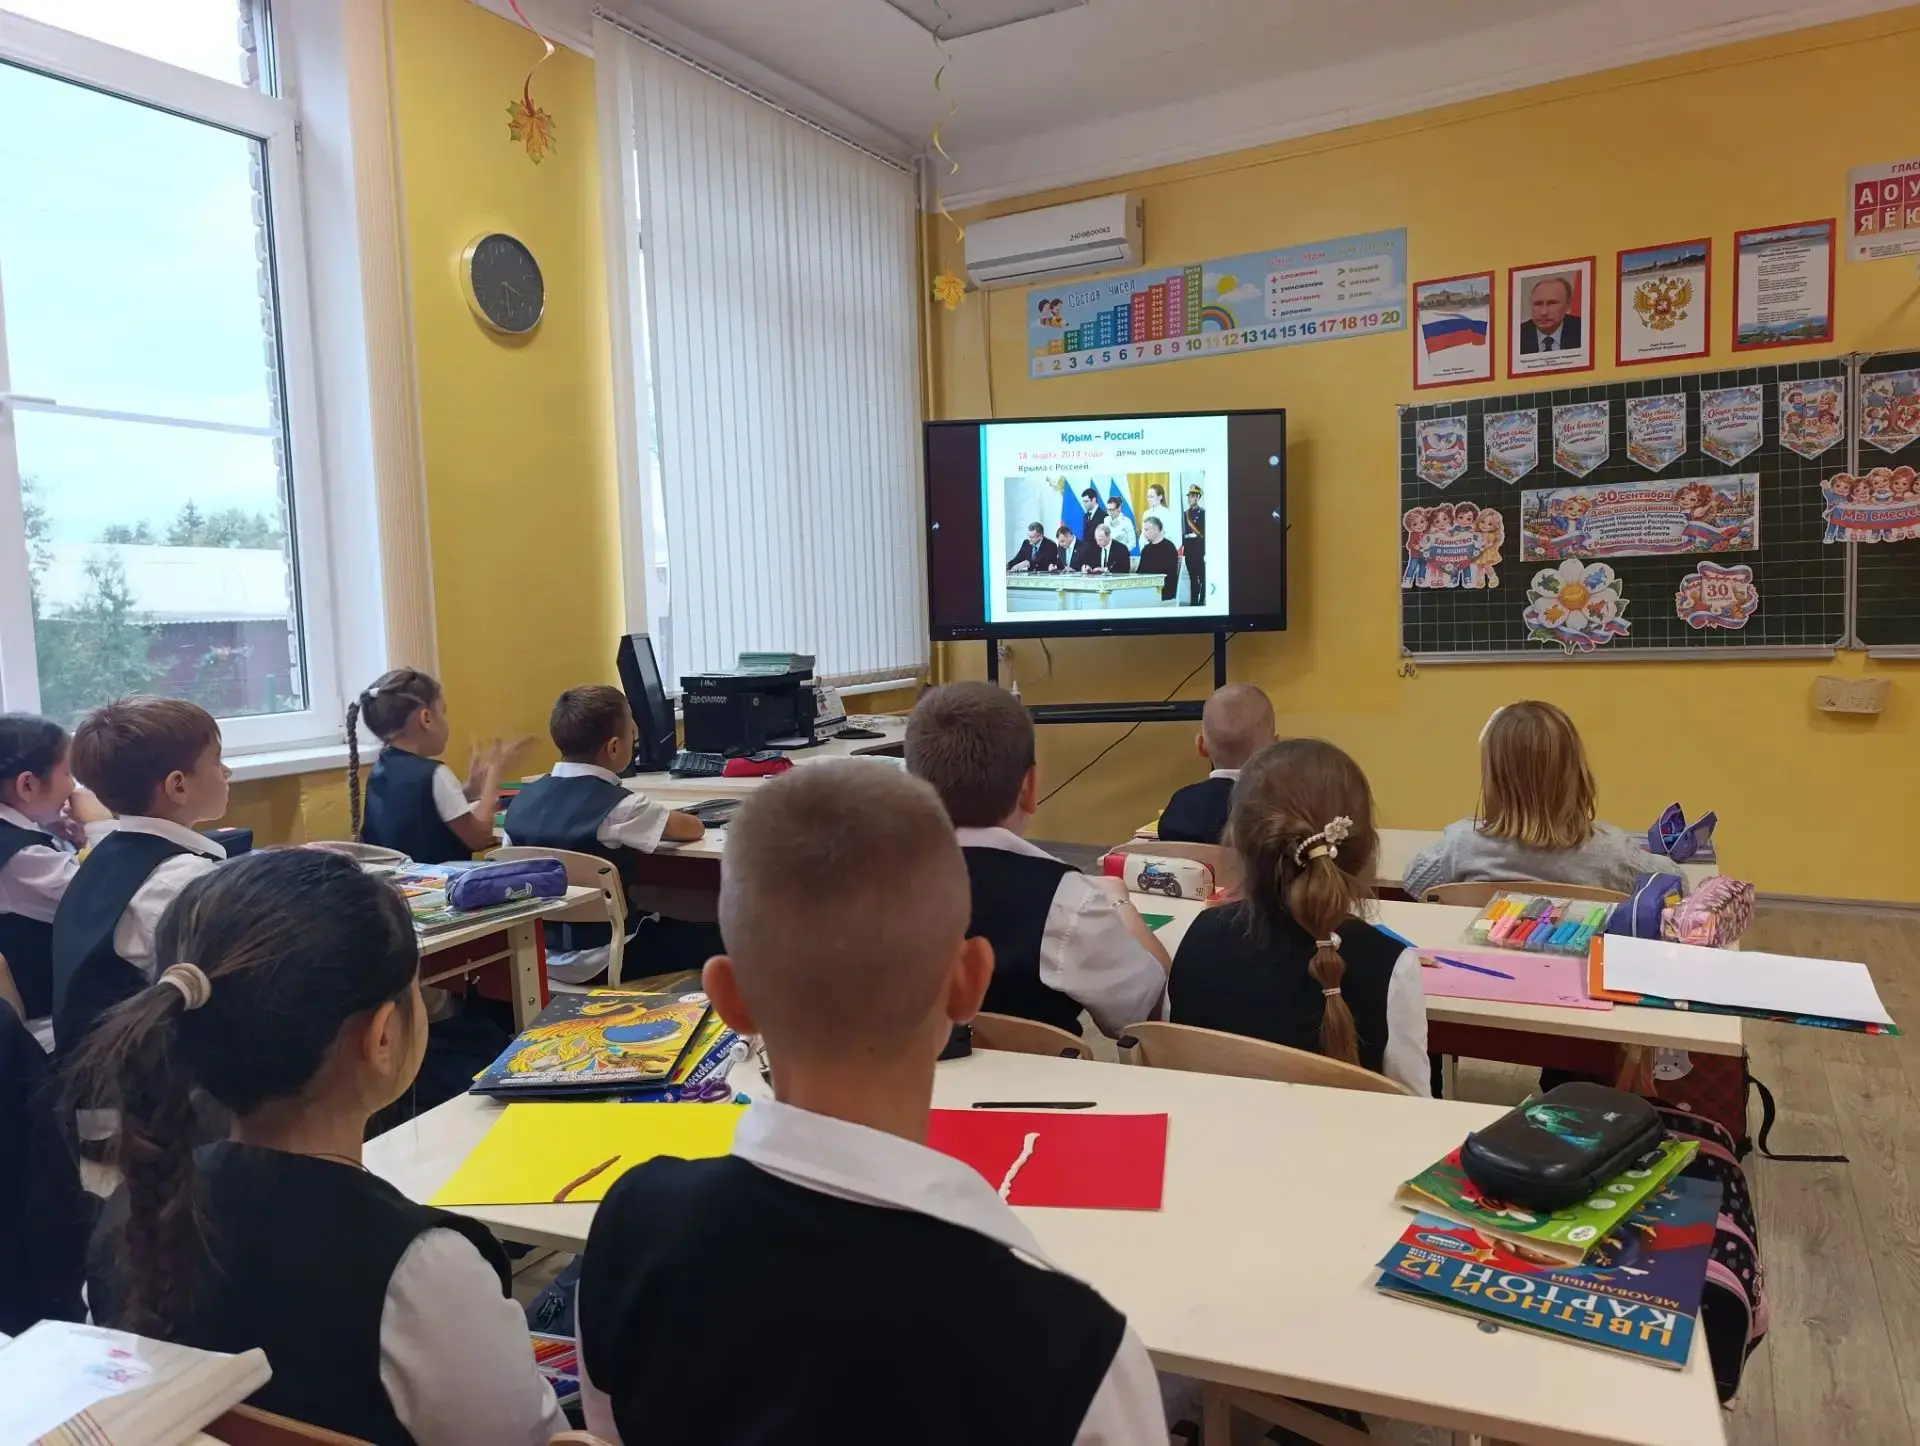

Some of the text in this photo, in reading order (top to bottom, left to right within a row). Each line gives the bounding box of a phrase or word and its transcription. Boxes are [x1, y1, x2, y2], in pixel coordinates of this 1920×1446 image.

[1892, 162, 1920, 174] ГЛАС
[1860, 180, 1920, 204] А О У
[1860, 215, 1872, 231] Я
[1885, 208, 1896, 228] Ё
[1280, 281, 1323, 293] умножение
[1068, 290, 1100, 307] Состав
[1036, 310, 1400, 372] 1 2 3 4 5 6 7 8 9 10 11 12 13 14 15 16 17 18 19 20
[1492, 431, 1510, 440] Одна
[1562, 424, 1575, 433] Мы
[1061, 432, 1092, 444] Крым
[1104, 429, 1144, 441] Россия!
[1141, 447, 1206, 456] воссоединения
[1492, 440, 1509, 449] Одна
[1598, 491, 1671, 503] 30 сентября
[1591, 505, 1679, 517] День воссоединения
[1842, 506, 1920, 521] Мы вместе!
[1707, 584, 1729, 597] 30
[1400, 1258, 1441, 1278] 12
[1458, 1262, 1678, 1331] КАРТОН
[1551, 1273, 1680, 1308] МЕЛОВАННЫЙ
[1450, 1275, 1673, 1346] ЦВЕТНОЙ
